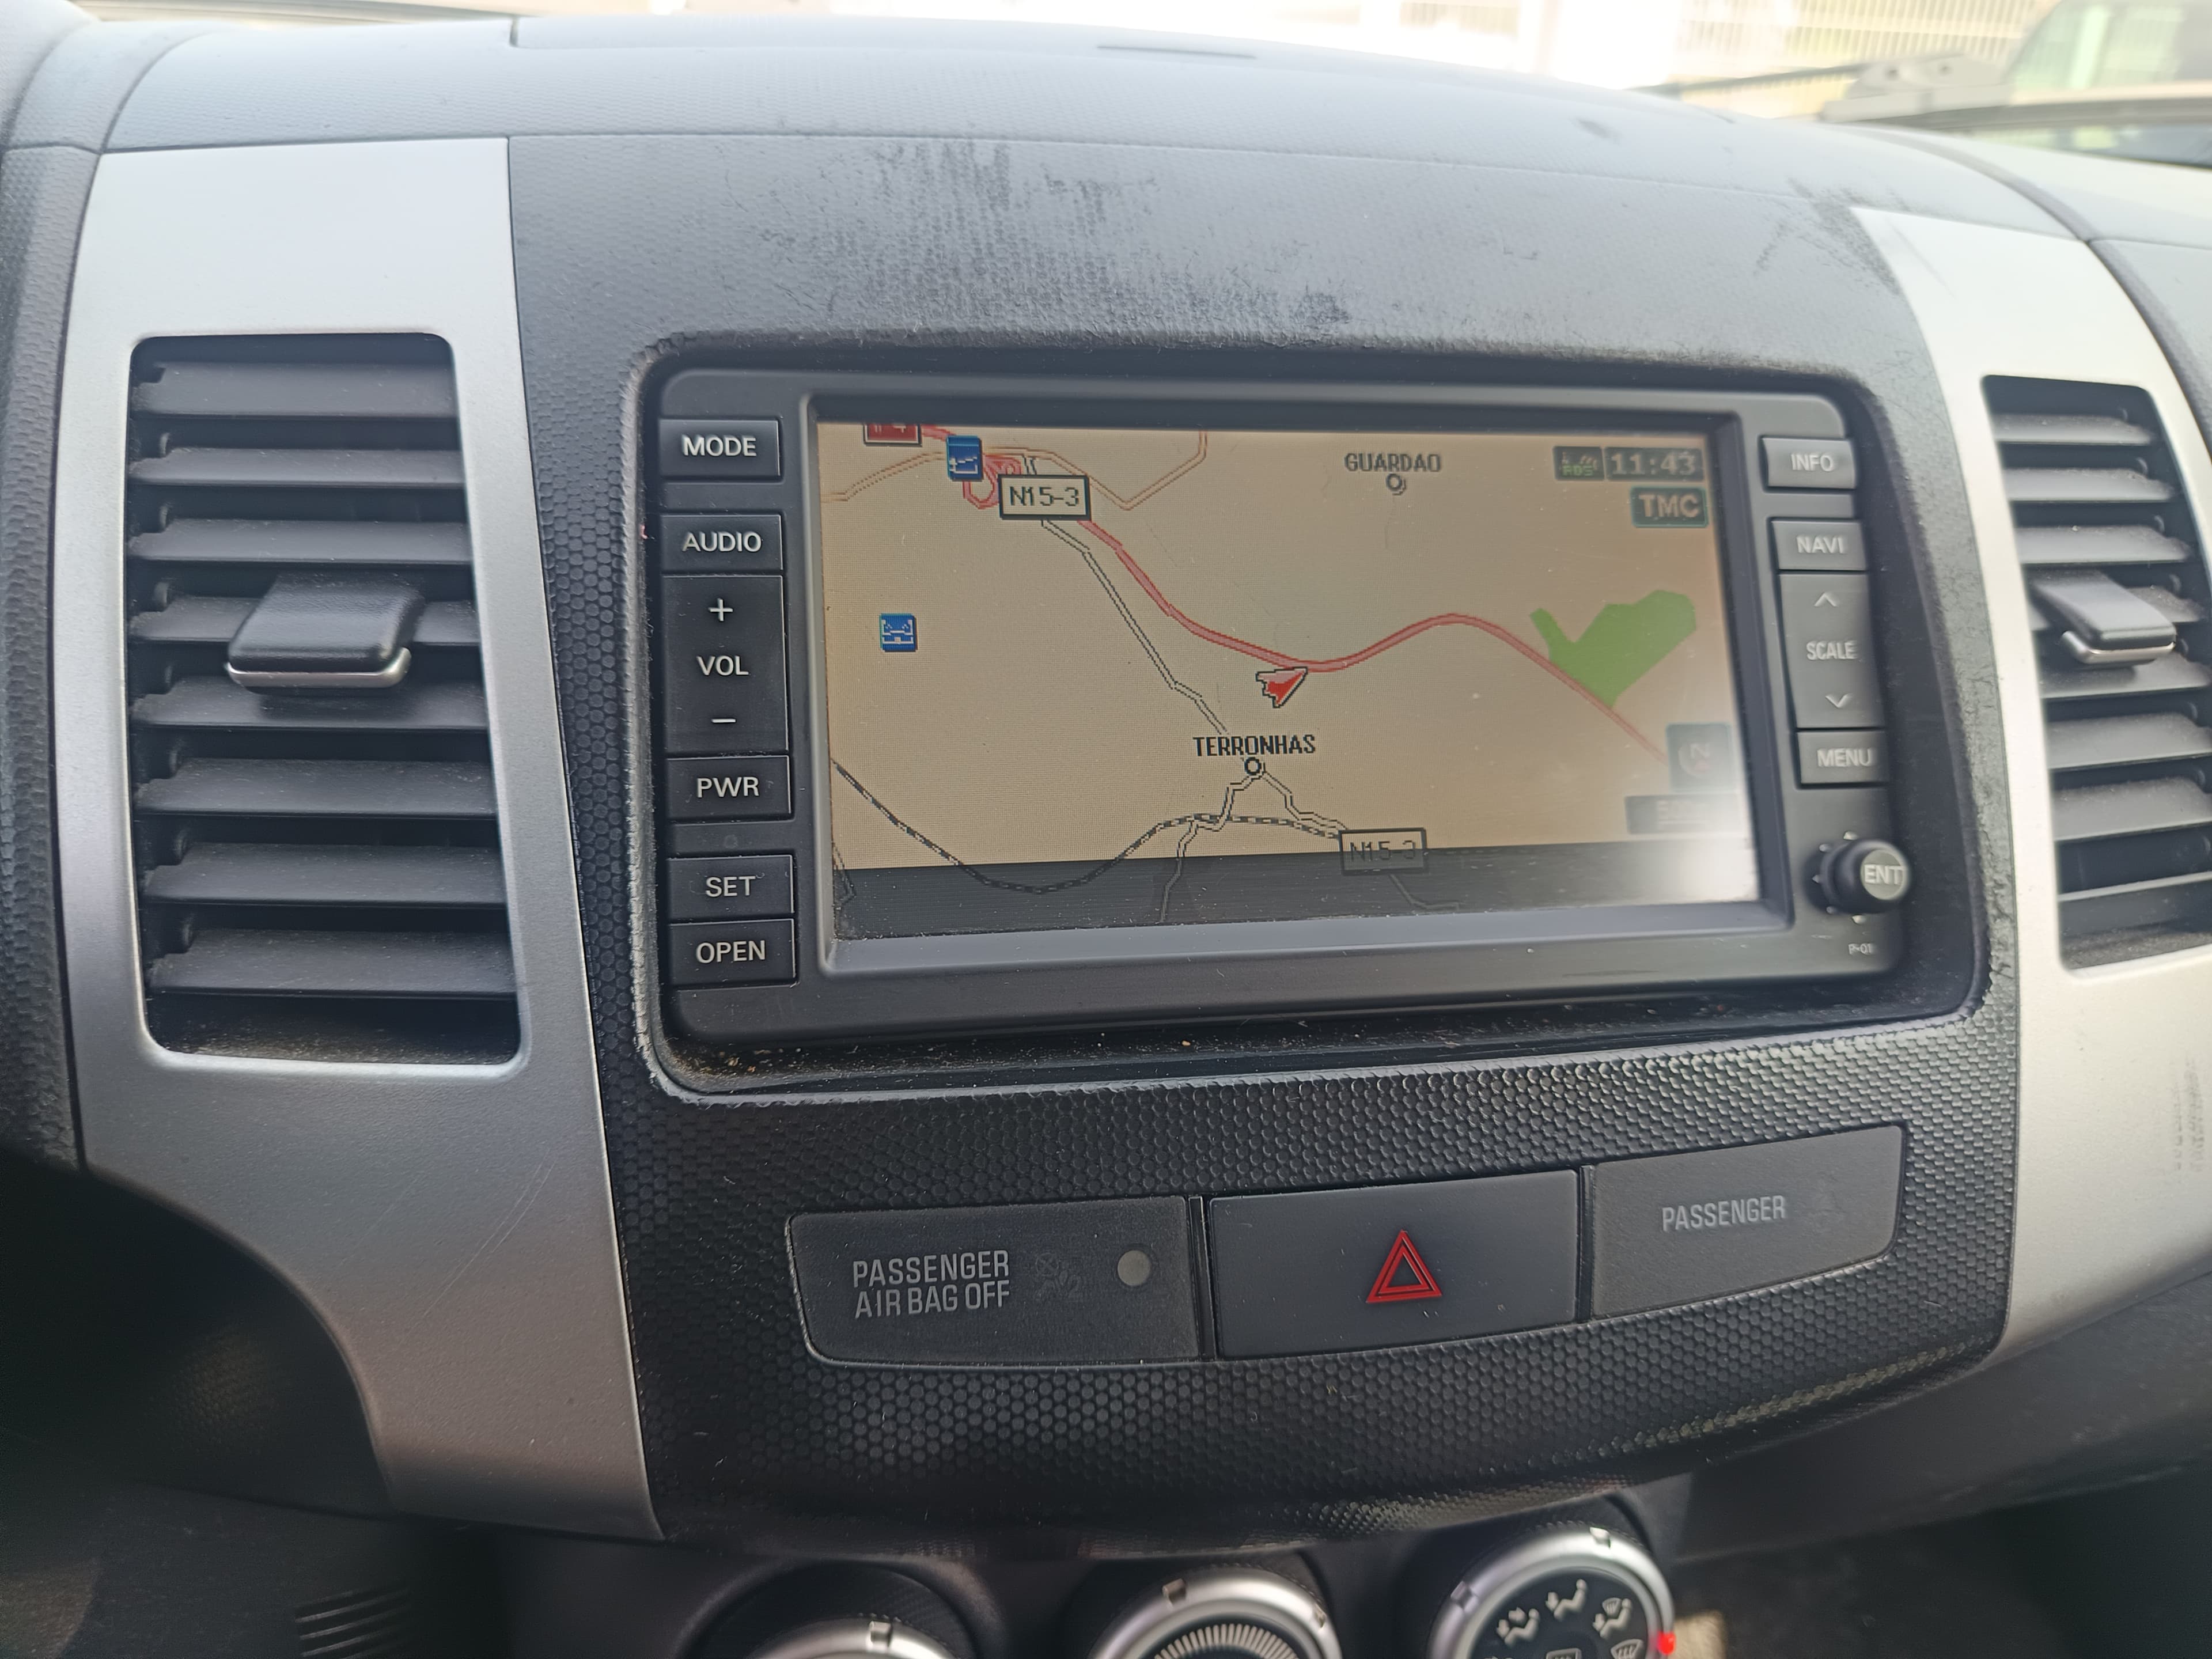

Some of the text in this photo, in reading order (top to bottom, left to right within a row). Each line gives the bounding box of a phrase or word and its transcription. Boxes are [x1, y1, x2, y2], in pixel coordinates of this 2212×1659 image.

[681, 434, 756, 457] MODE
[1344, 453, 1442, 472] GUARDAO
[1612, 451, 1696, 475] 11:43
[1790, 453, 1835, 472] INFO
[1010, 486, 1080, 507] N15-3
[1639, 494, 1699, 517] TMC
[681, 532, 762, 552] AUDIO
[1797, 536, 1844, 554] NAVI
[1806, 640, 1858, 661] SCALE
[696, 656, 749, 676] VOL
[1192, 734, 1316, 757] TERRONHAS
[1817, 749, 1874, 768] MENU
[696, 777, 760, 798] PWR
[704, 875, 756, 897] SET
[1863, 864, 1903, 887] ENT
[695, 940, 766, 964] OPEN
[1662, 1195, 1786, 1232] PASSENGER
[853, 1249, 1009, 1287] PASSENGER
[965, 1280, 1010, 1309] OFF
